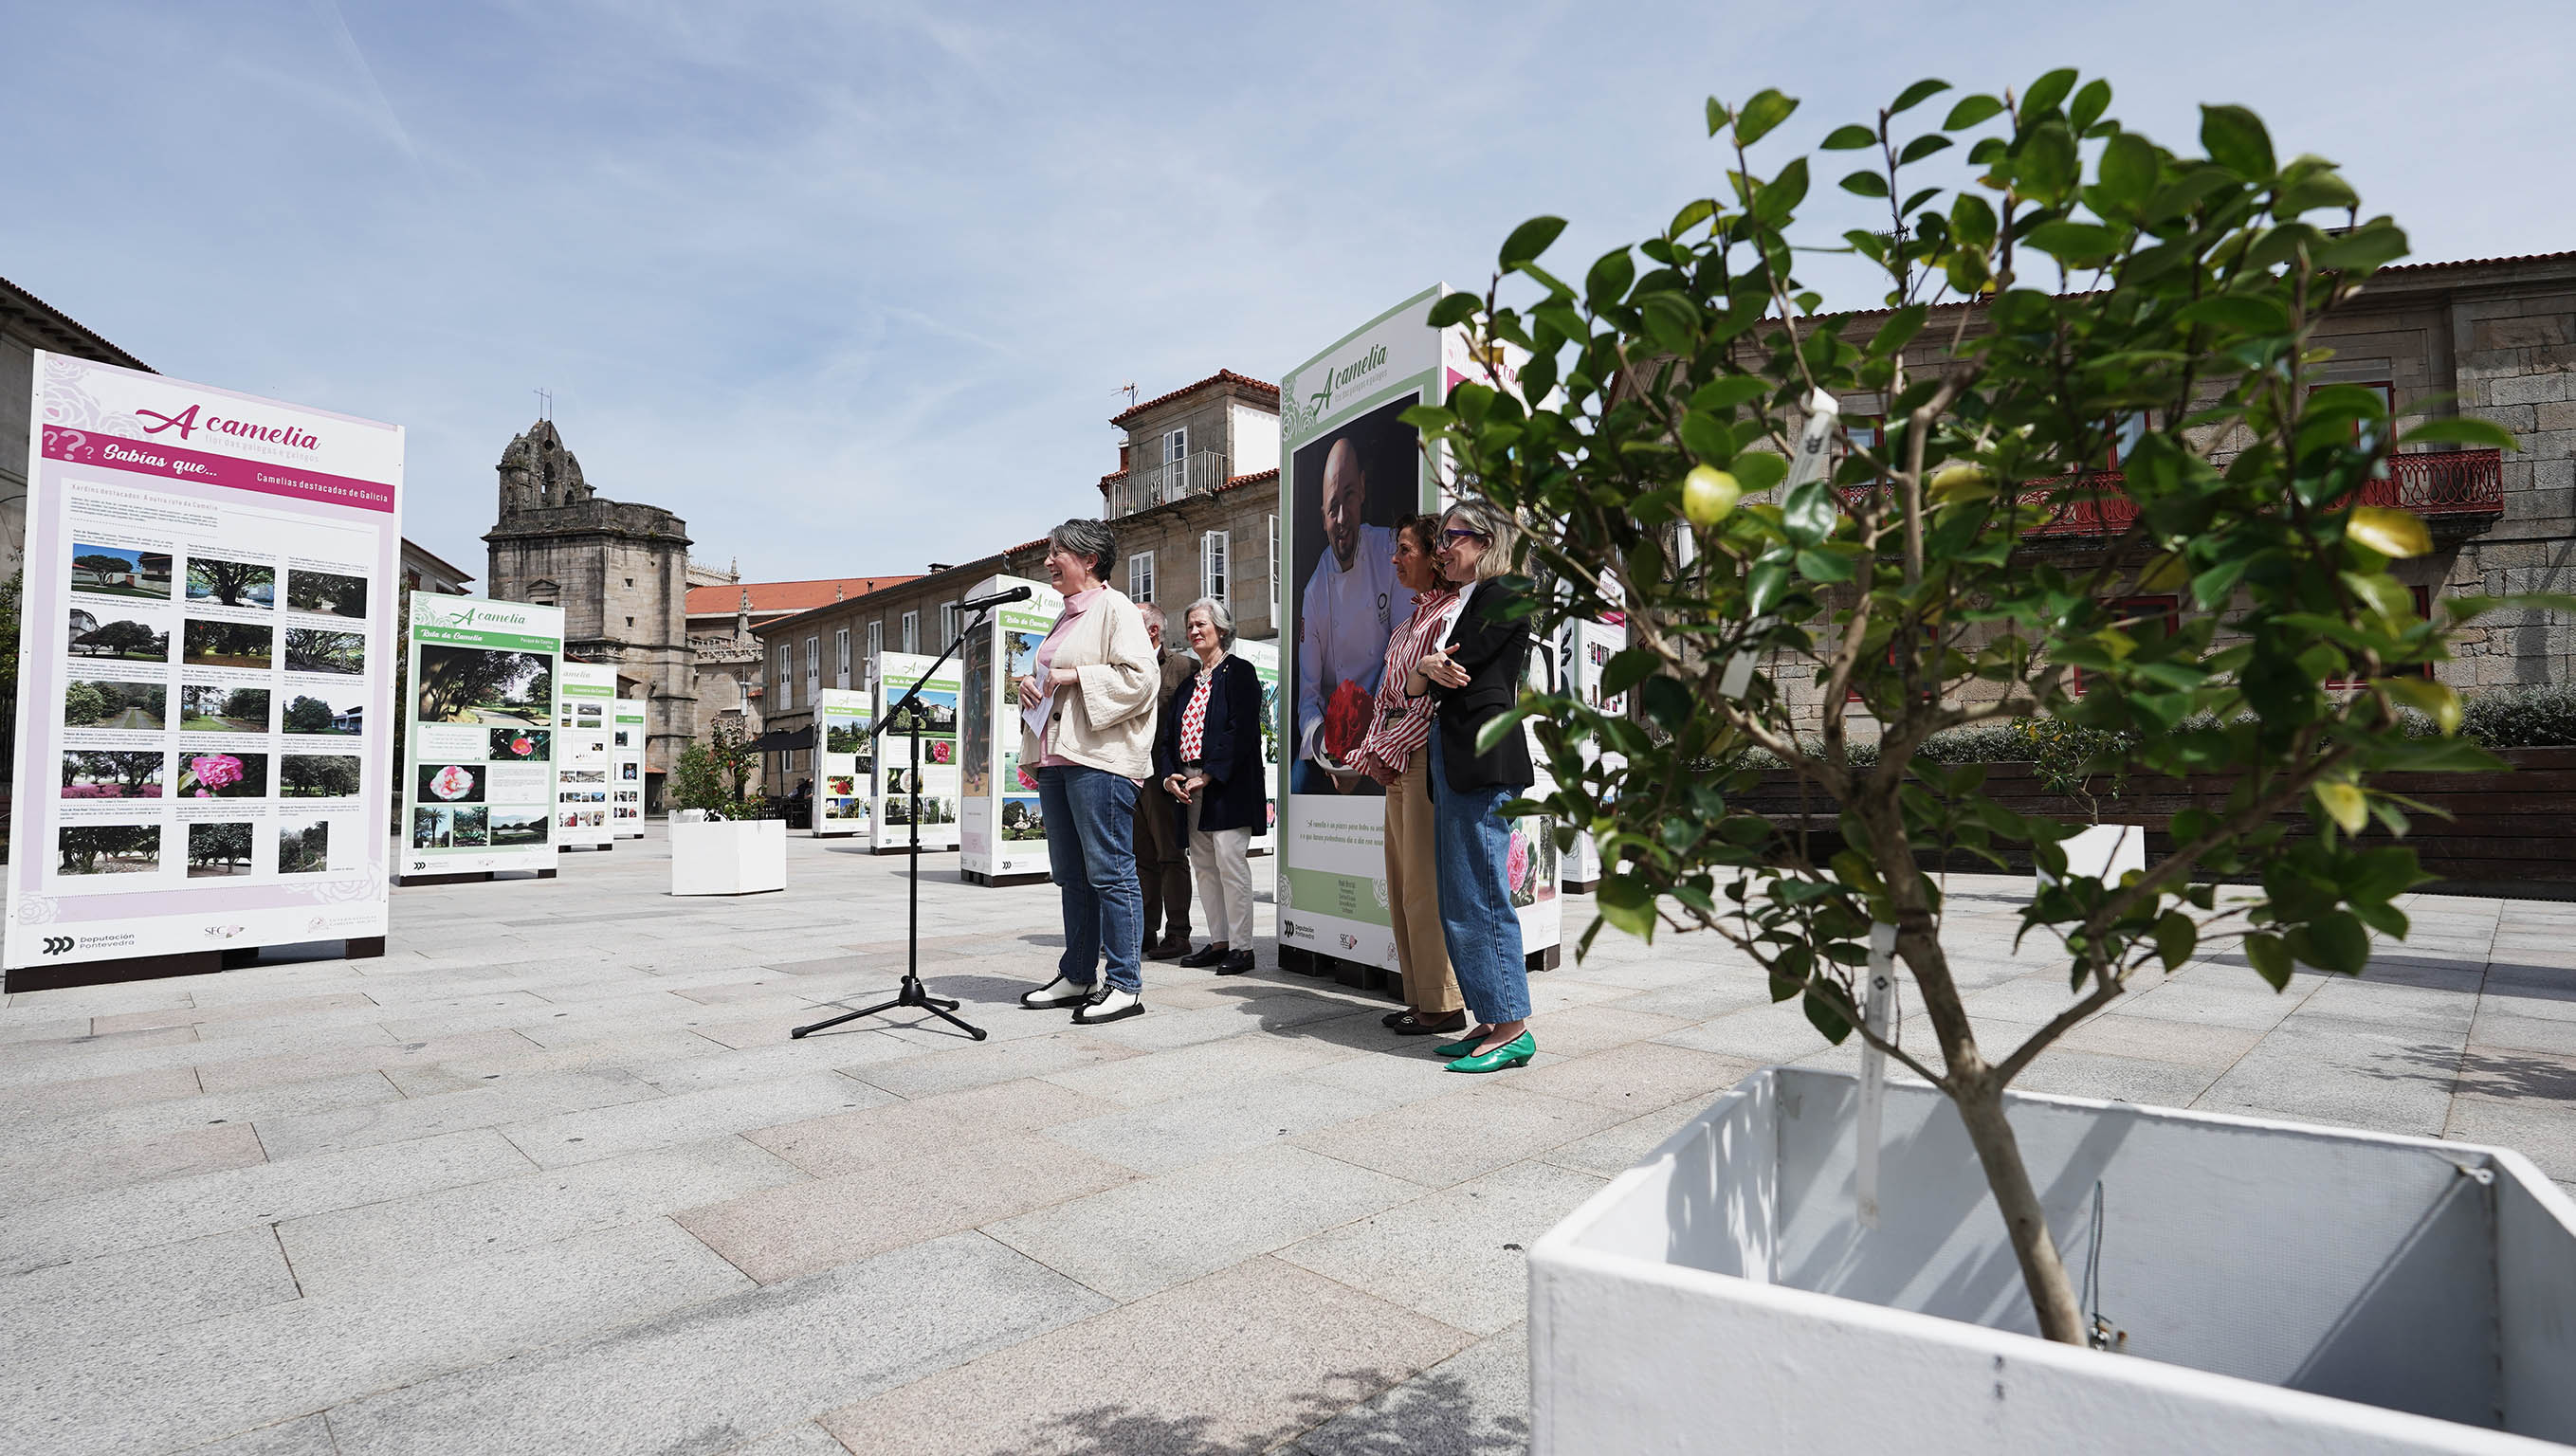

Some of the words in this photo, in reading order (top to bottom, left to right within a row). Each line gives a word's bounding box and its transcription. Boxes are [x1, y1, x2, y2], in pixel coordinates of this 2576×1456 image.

[1309, 367, 1335, 417] A
[1335, 343, 1389, 390] camelia
[135, 404, 200, 440] A
[206, 416, 321, 450] camelia
[256, 472, 298, 488] Camelias
[299, 480, 347, 496] destacadas
[348, 488, 358, 498] de
[359, 489, 388, 503] Galicia
[449, 607, 476, 626] A
[478, 612, 525, 625] camelia
[453, 631, 483, 642] Camelia
[80, 933, 136, 943] Deputación
[80, 939, 136, 949] Pontevedra
